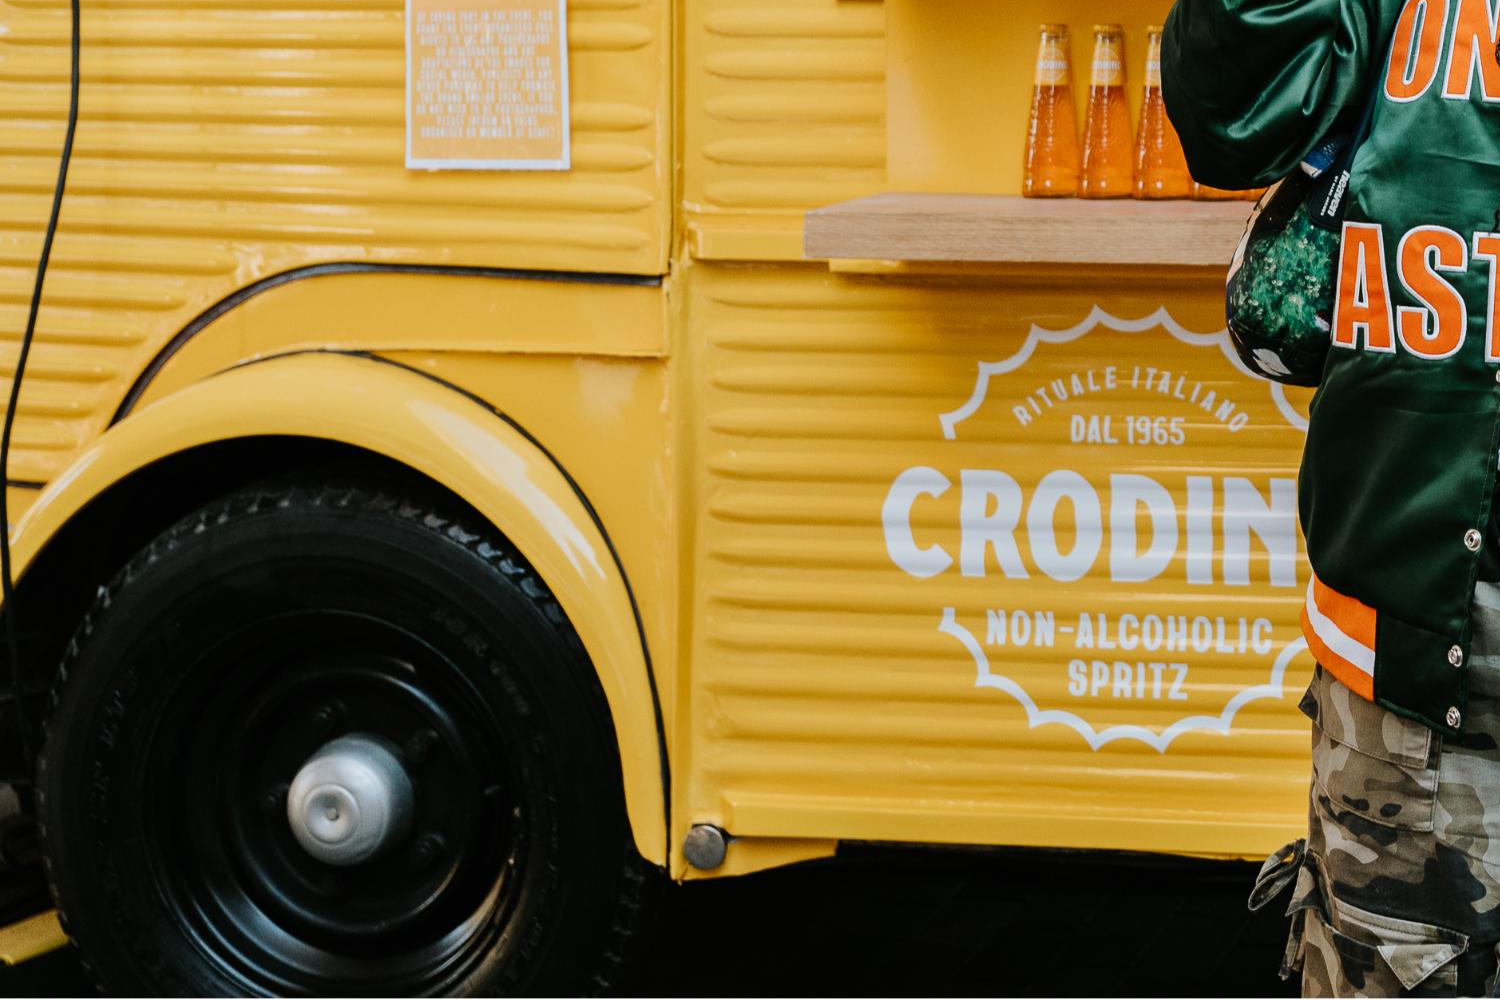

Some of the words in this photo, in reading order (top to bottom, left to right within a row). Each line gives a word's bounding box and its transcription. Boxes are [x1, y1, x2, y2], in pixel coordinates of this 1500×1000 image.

[1012, 366, 1118, 425] RITUALE
[1131, 366, 1249, 433] ITALIANO
[1071, 415, 1119, 444] DAL
[1126, 416, 1186, 445] 1965
[986, 609, 1274, 654] NON-ALCOHOLIC
[1068, 659, 1189, 700] SPRITZ
